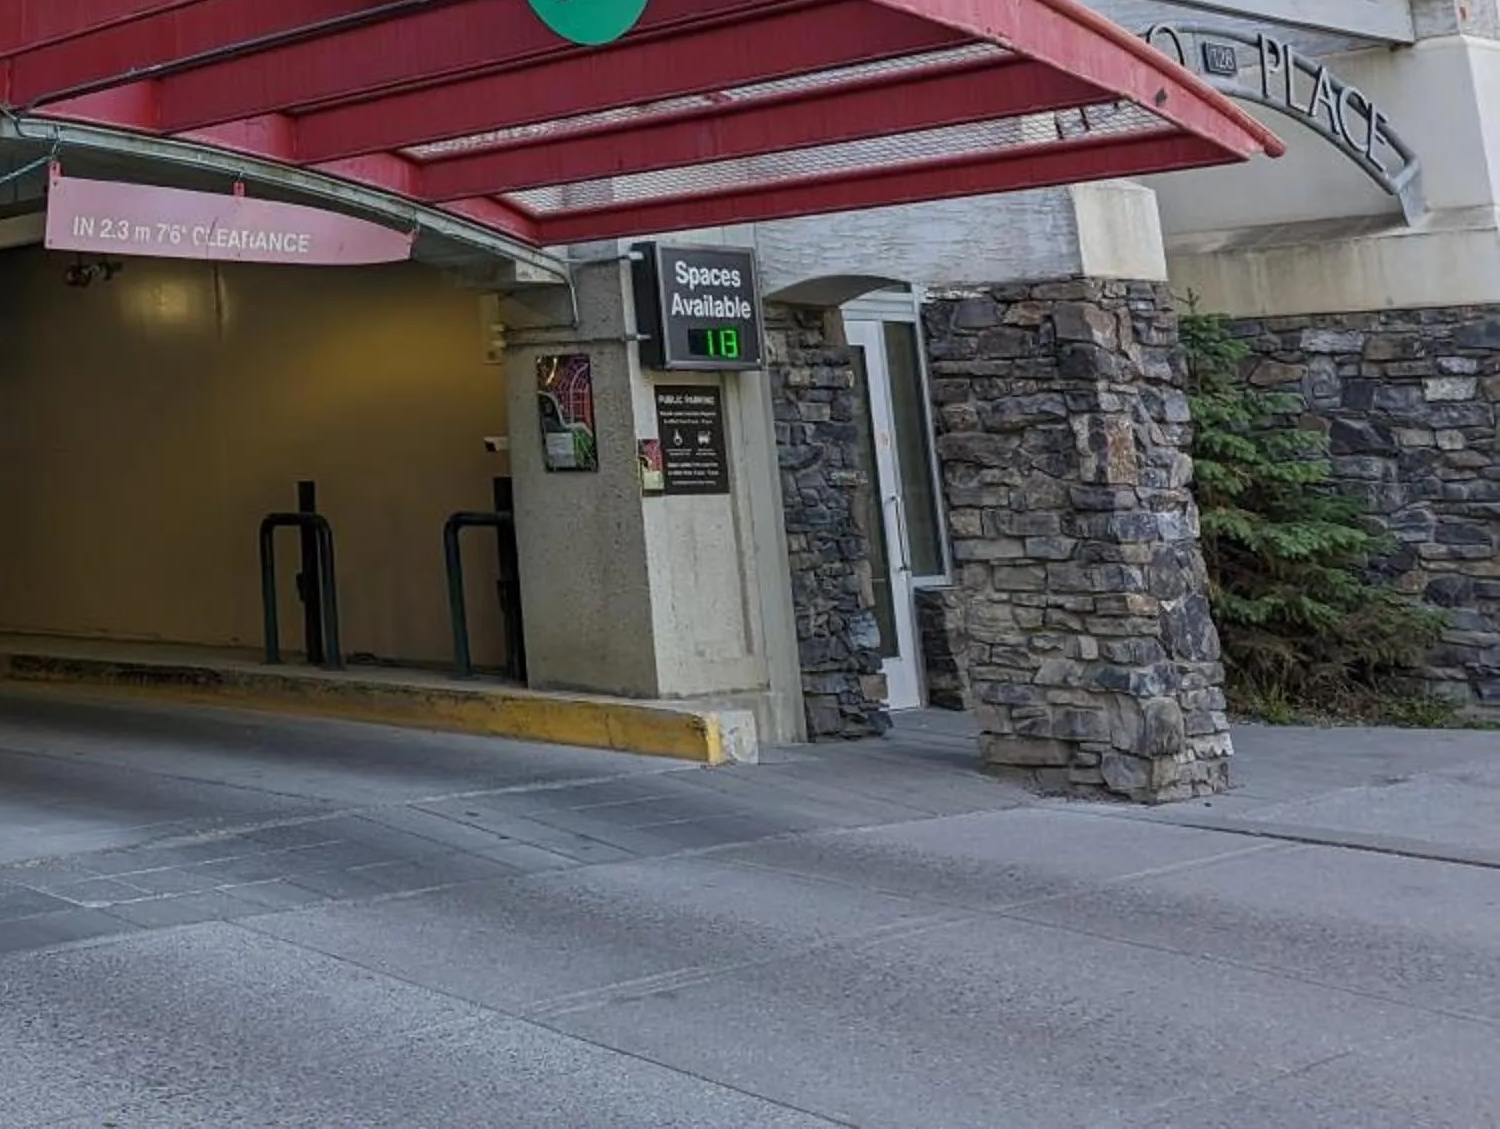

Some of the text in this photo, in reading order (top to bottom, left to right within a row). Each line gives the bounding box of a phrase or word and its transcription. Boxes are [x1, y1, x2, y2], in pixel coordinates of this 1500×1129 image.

[1257, 33, 1388, 173] PLACE
[73, 215, 94, 237] IN
[100, 219, 129, 240] 2.3
[135, 225, 150, 243] m
[192, 226, 312, 253] CLEARANCE
[675, 260, 741, 288] Spaces
[671, 292, 751, 319] Available
[705, 330, 739, 358] 18
